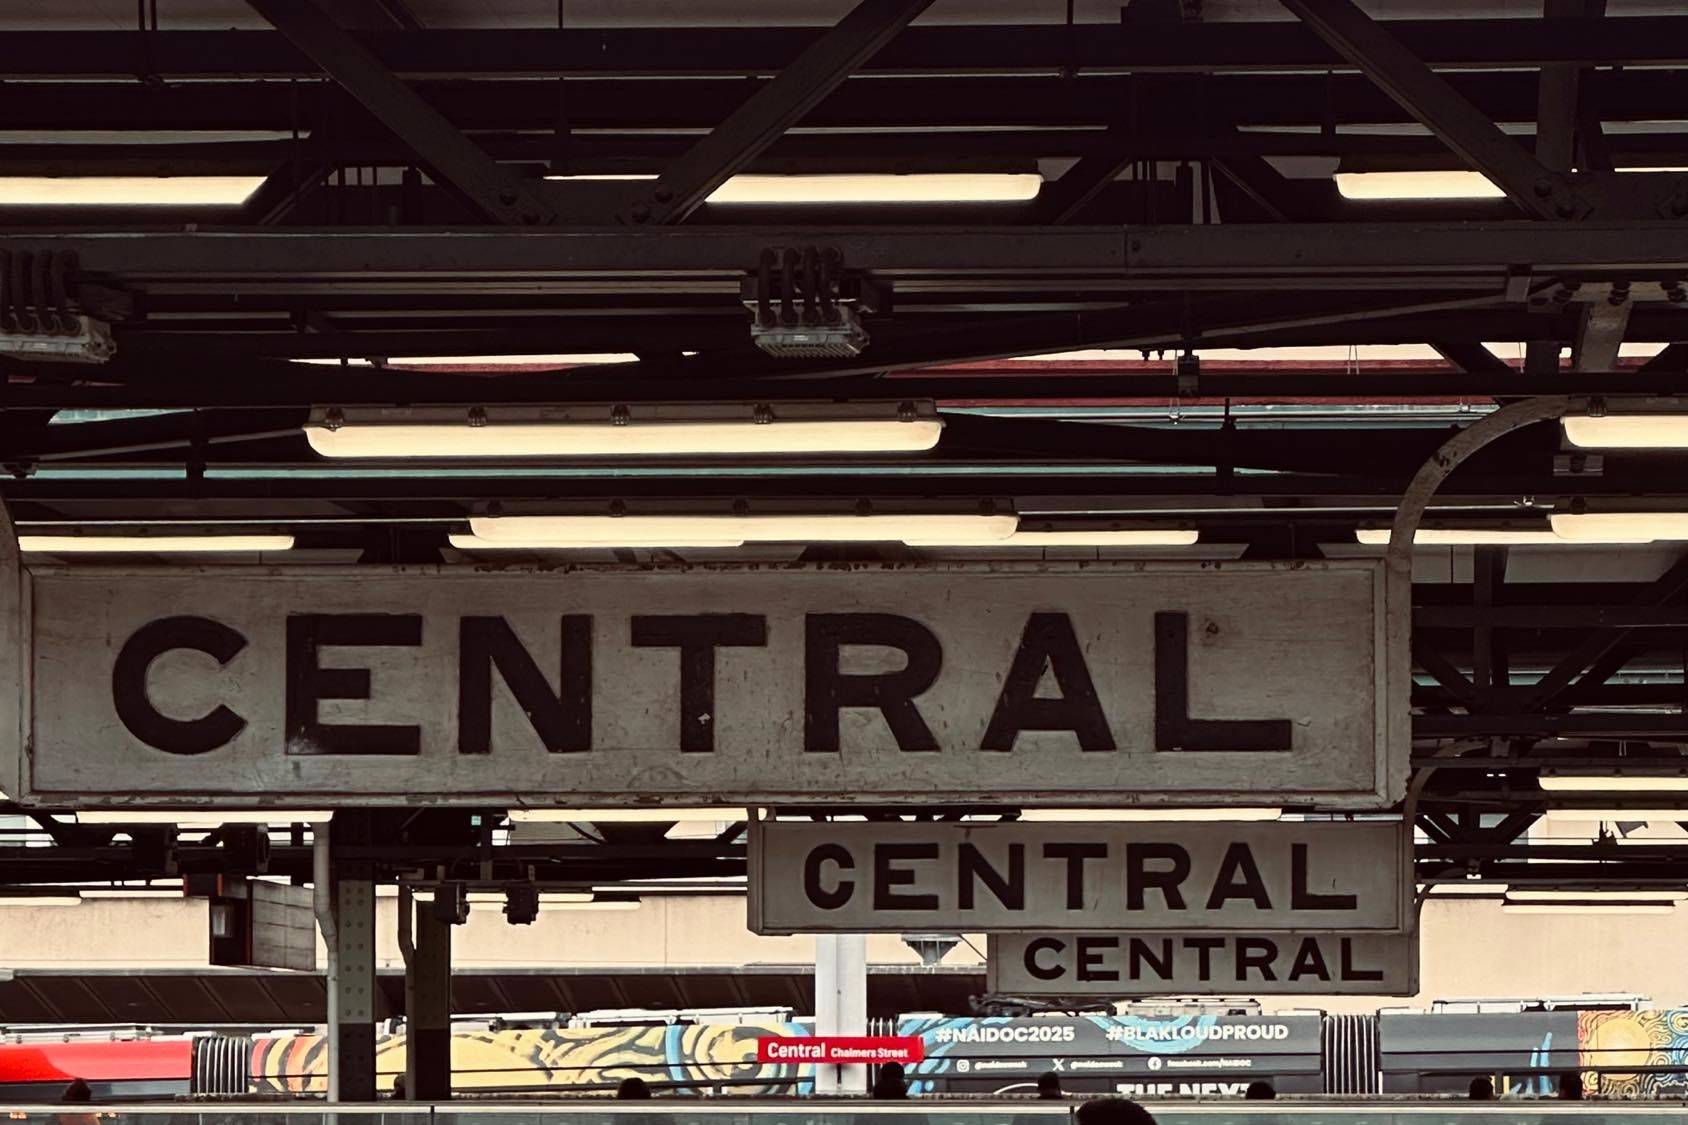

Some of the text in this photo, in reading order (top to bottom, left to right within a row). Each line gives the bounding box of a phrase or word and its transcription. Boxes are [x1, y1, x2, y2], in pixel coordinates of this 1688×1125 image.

[112, 611, 1293, 756] CENTRAL
[803, 842, 1357, 911] CENTRAL
[1023, 936, 1384, 982] CENTRAL
[935, 1025, 1075, 1043] #NAIDOC2025
[1105, 1024, 1289, 1041] #BLAKLOUDPROUD
[767, 1042, 909, 1058] Central Chalmers Street
